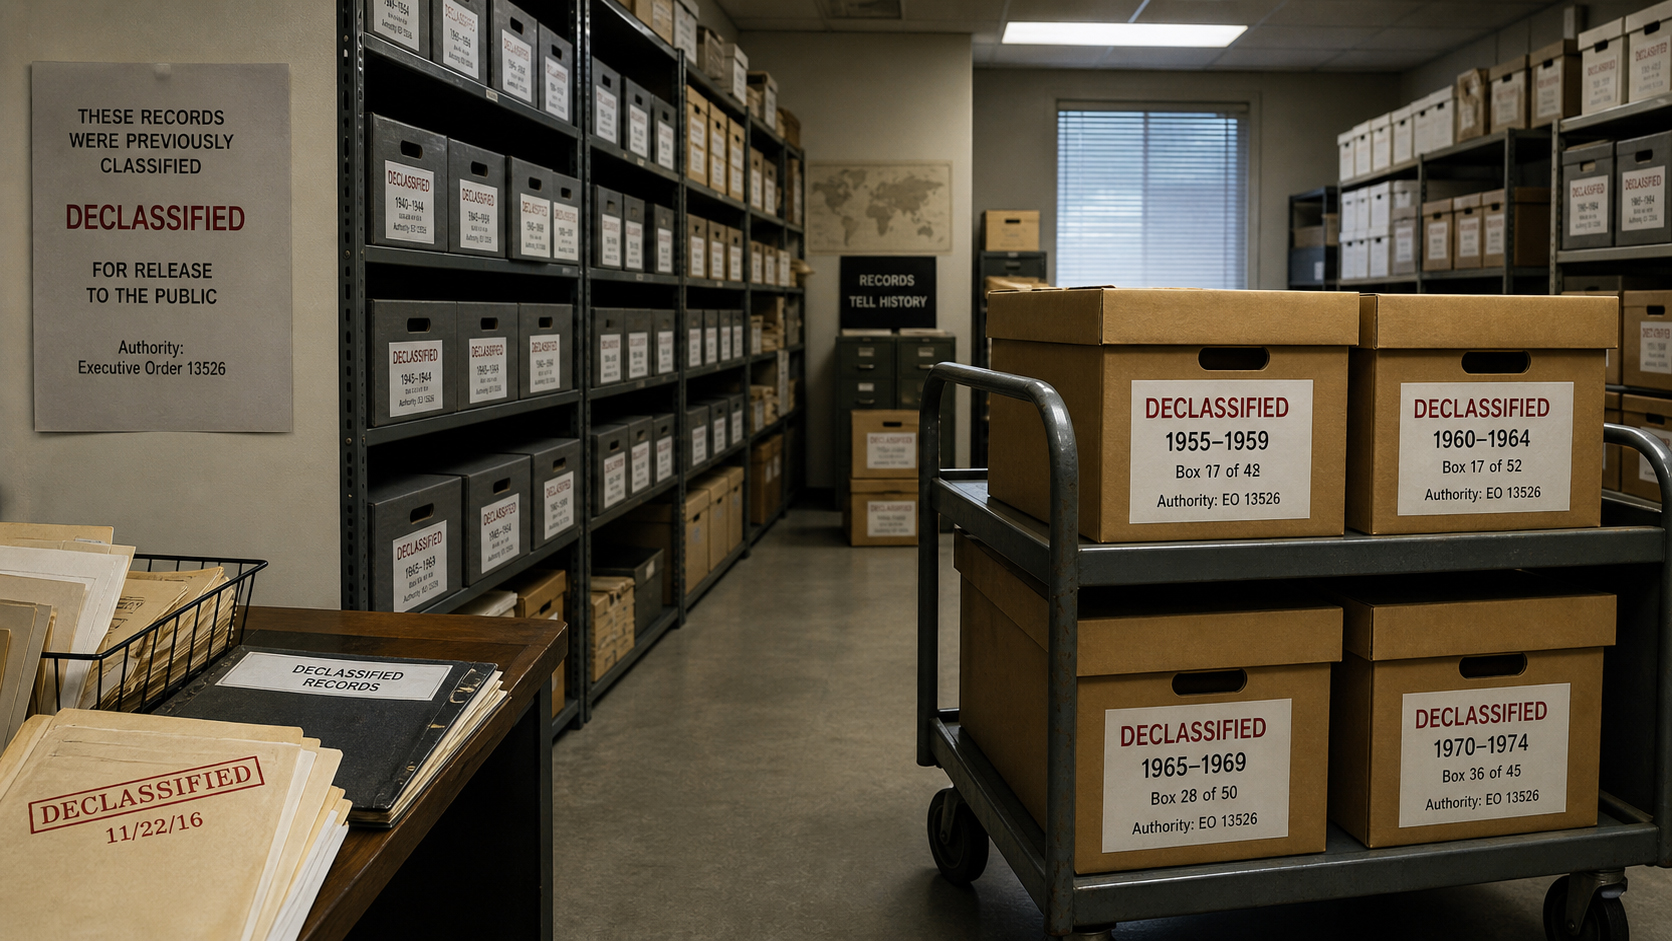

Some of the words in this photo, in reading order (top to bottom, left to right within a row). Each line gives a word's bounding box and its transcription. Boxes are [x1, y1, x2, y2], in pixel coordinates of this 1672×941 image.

[78, 109, 134, 125] THESE
[141, 109, 224, 125] RECORDS
[69, 133, 119, 149] WERE
[126, 133, 234, 149] PREVIOUSLY
[101, 158, 201, 174] CLASSIFIED
[66, 204, 245, 231] DECLASSIFIED
[92, 262, 127, 278] FOR
[134, 262, 212, 279] RELEASE
[859, 275, 915, 286] RECORDS
[87, 288, 108, 303] TO
[115, 288, 148, 303] THE
[155, 288, 217, 304] PUBLIC
[850, 296, 876, 307] TELL
[880, 296, 927, 307] HISTORY
[118, 340, 183, 357] Authority:
[393, 349, 438, 364] DECLASSIFIED
[78, 360, 140, 375] Executive
[145, 362, 182, 375] Order
[188, 362, 226, 376] 13526
[1146, 397, 1289, 419] DECLASSIFIED
[1414, 398, 1550, 418] DECLASSIFIED
[1166, 430, 1269, 451] 1955–1959
[1434, 429, 1530, 448] 1960–1964
[1176, 465, 1200, 479] Box
[1226, 464, 1239, 477] of
[1443, 460, 1466, 473] Box
[1471, 460, 1484, 473] 17
[1489, 460, 1502, 472] of
[1507, 459, 1522, 472] 52
[1157, 494, 1218, 509] Authority:
[1222, 493, 1239, 506] EO
[1245, 492, 1280, 505] 13526
[1425, 488, 1482, 503] Authority:
[1487, 487, 1502, 499] EO
[1507, 486, 1541, 499] 13526
[397, 531, 442, 561] DECLASSIFIED
[292, 664, 404, 680] DECLASSIFIED
[302, 678, 380, 691] RECORDS
[1416, 701, 1547, 729] DECLASSIFIED
[1121, 718, 1266, 747] DECLASSIFIED
[1434, 733, 1529, 758] 1970–1974
[1142, 752, 1246, 778] 1965–1969
[1442, 770, 1465, 783] Box
[1469, 767, 1484, 781] 36
[1489, 765, 1502, 779] of
[1506, 764, 1521, 777] 45
[40, 765, 251, 824] DECLASSIFIED
[1151, 791, 1176, 805] Box
[1181, 789, 1197, 803] 28
[1203, 787, 1217, 801] of
[1221, 786, 1237, 799] 50
[1425, 796, 1481, 811] Authority:
[1486, 793, 1501, 805] EO
[1506, 790, 1539, 803] 13526
[106, 812, 203, 844] 11/22/16
[1132, 819, 1194, 835] Authority:
[1199, 816, 1216, 829] EO
[1221, 812, 1257, 827] 13526
